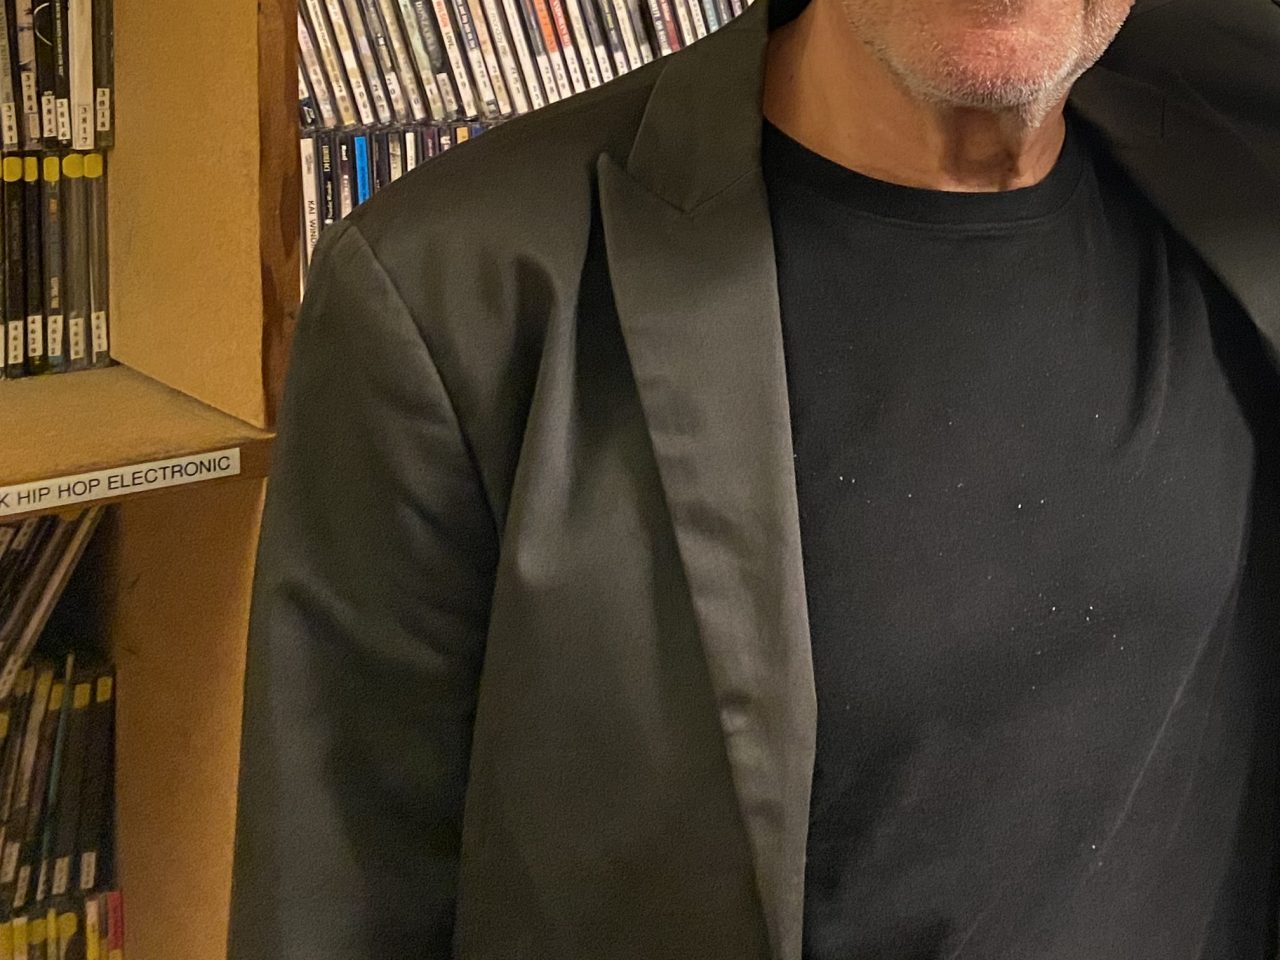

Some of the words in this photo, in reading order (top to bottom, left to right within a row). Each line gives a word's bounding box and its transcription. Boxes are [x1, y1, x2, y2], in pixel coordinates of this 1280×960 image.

[307, 200, 316, 215] KAI
[17, 487, 51, 505] HIP
[59, 478, 101, 498] HOP
[108, 456, 230, 490] ELECTRONIC
